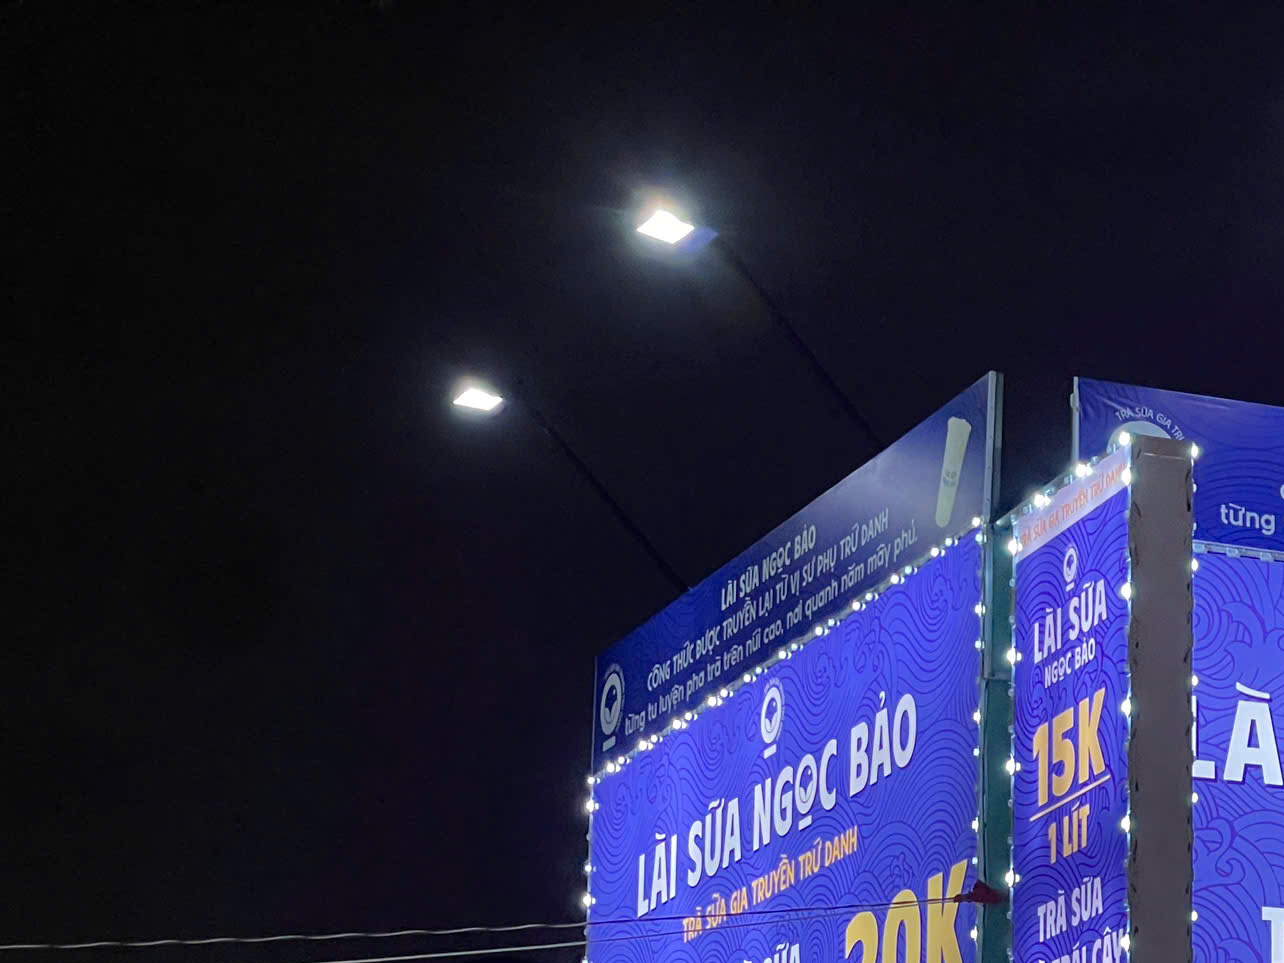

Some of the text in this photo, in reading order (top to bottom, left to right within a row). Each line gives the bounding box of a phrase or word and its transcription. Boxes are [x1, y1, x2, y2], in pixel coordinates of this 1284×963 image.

[1220, 502, 1276, 535] từng
[1033, 579, 1107, 665] LÀI SỮA
[1044, 637, 1096, 689] NGỌC BẢO
[1032, 687, 1106, 807] 15K
[637, 832, 678, 918] LÀI
[687, 798, 742, 888] SỮA
[752, 739, 837, 852] NGỌC
[849, 690, 917, 798] BẢO
[1063, 802, 1089, 859] LÍT
[705, 893, 726, 929] SỮA
[730, 886, 748, 915] GIA
[752, 854, 795, 905] TRUYỀN
[825, 825, 858, 867] DANH
[1037, 876, 1103, 943] TRÀ SỮA
